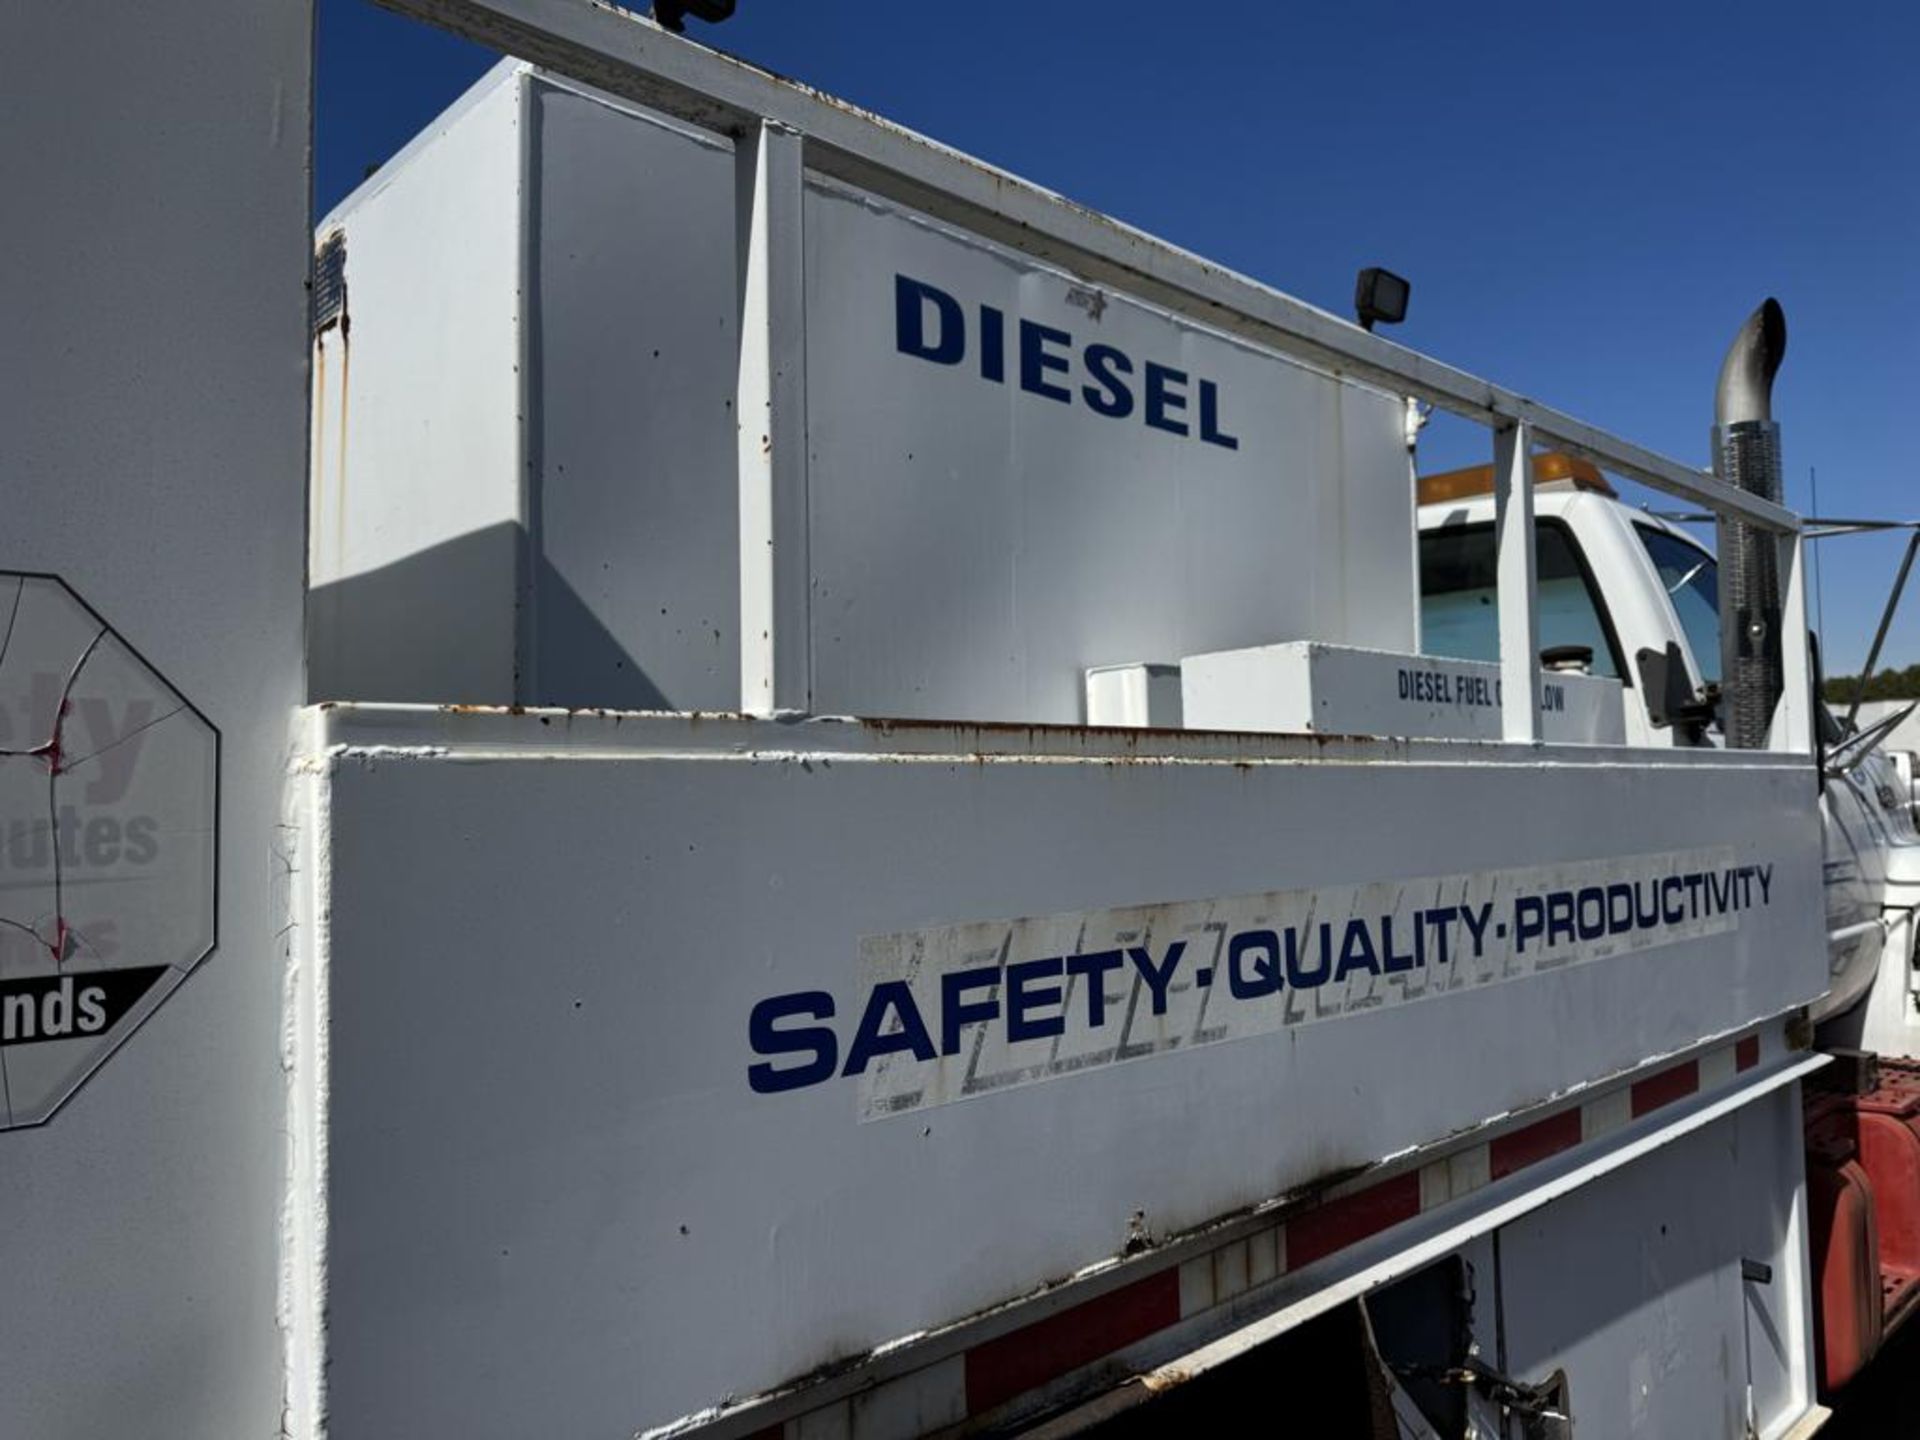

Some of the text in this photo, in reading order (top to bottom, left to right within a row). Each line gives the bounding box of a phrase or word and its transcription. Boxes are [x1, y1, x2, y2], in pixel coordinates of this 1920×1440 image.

[895, 273, 1238, 450] DIESEL
[1398, 669, 1453, 704] DIESEL
[1456, 675, 1492, 707] FUEL
[1229, 902, 1494, 1000] QUALITY
[1515, 863, 1773, 953] PRODUCTIVITY
